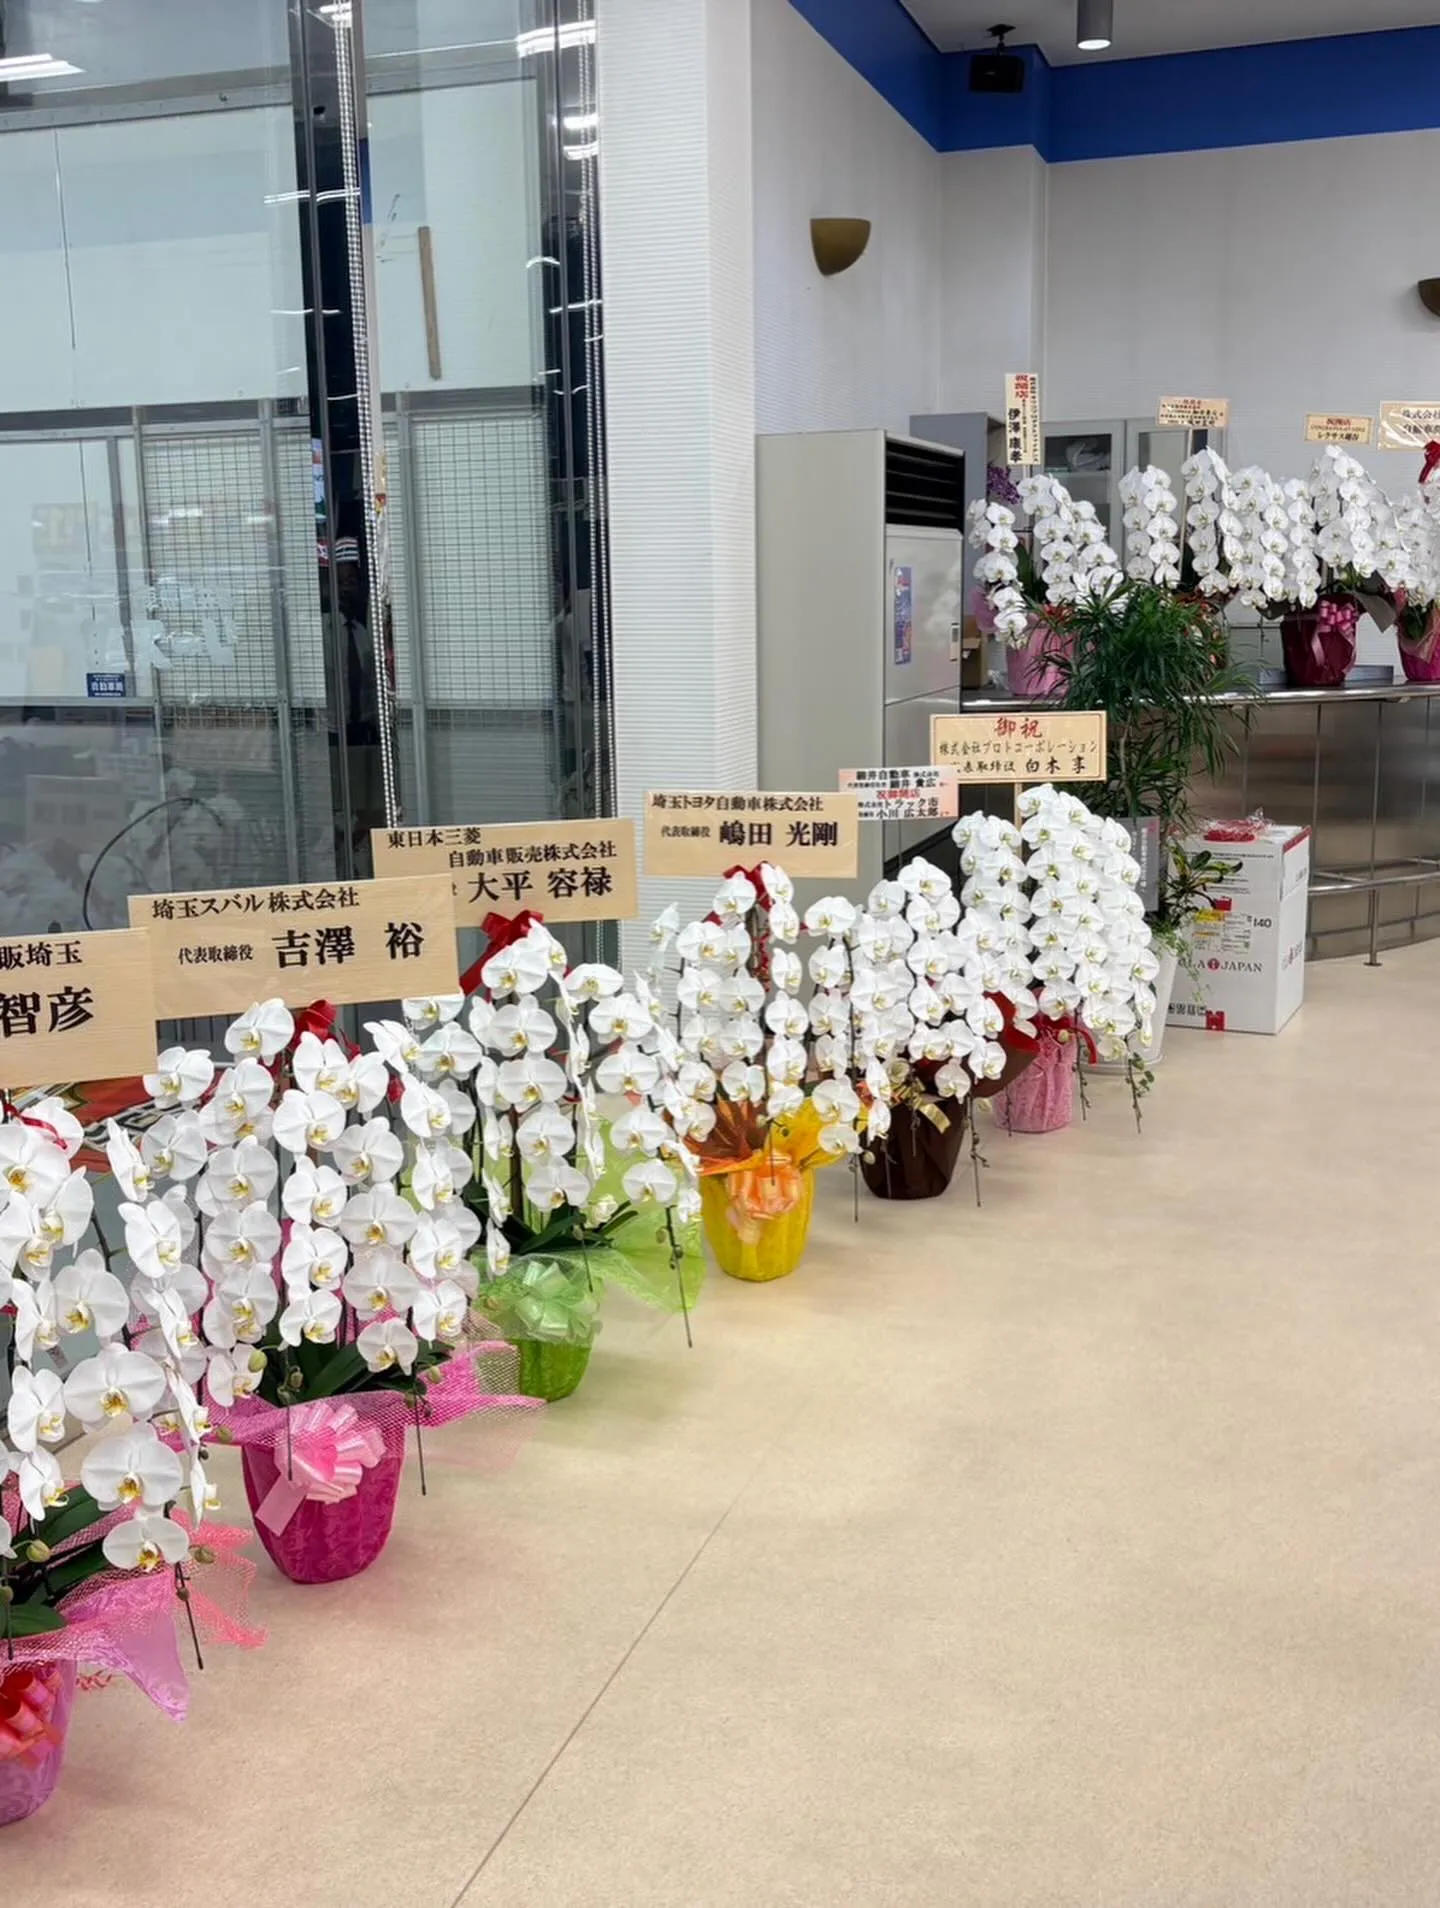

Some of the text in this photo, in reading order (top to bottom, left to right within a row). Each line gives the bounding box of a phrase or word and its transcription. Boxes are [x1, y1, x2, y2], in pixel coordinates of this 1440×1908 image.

[994, 717, 1042, 739] 御祝
[939, 740, 1097, 756] 株式会社プロトコーポレーション
[652, 794, 824, 812] 埼玉トヨタ自動車株式会社
[876, 808, 899, 819] 小川
[903, 807, 938, 818] 広太郎
[388, 827, 481, 849] 東日本三菱
[661, 820, 837, 847] 代表取締役 嶋田 光剛
[449, 840, 617, 868] 自動車販売株式会社
[468, 870, 534, 903] 大平
[547, 865, 612, 899] 容禄
[1253, 918, 1272, 928] 140
[178, 921, 424, 969] 代表取締役 吉澤 裕
[1221, 960, 1262, 973] JAPAN
[0, 985, 94, 1039] 智彦
